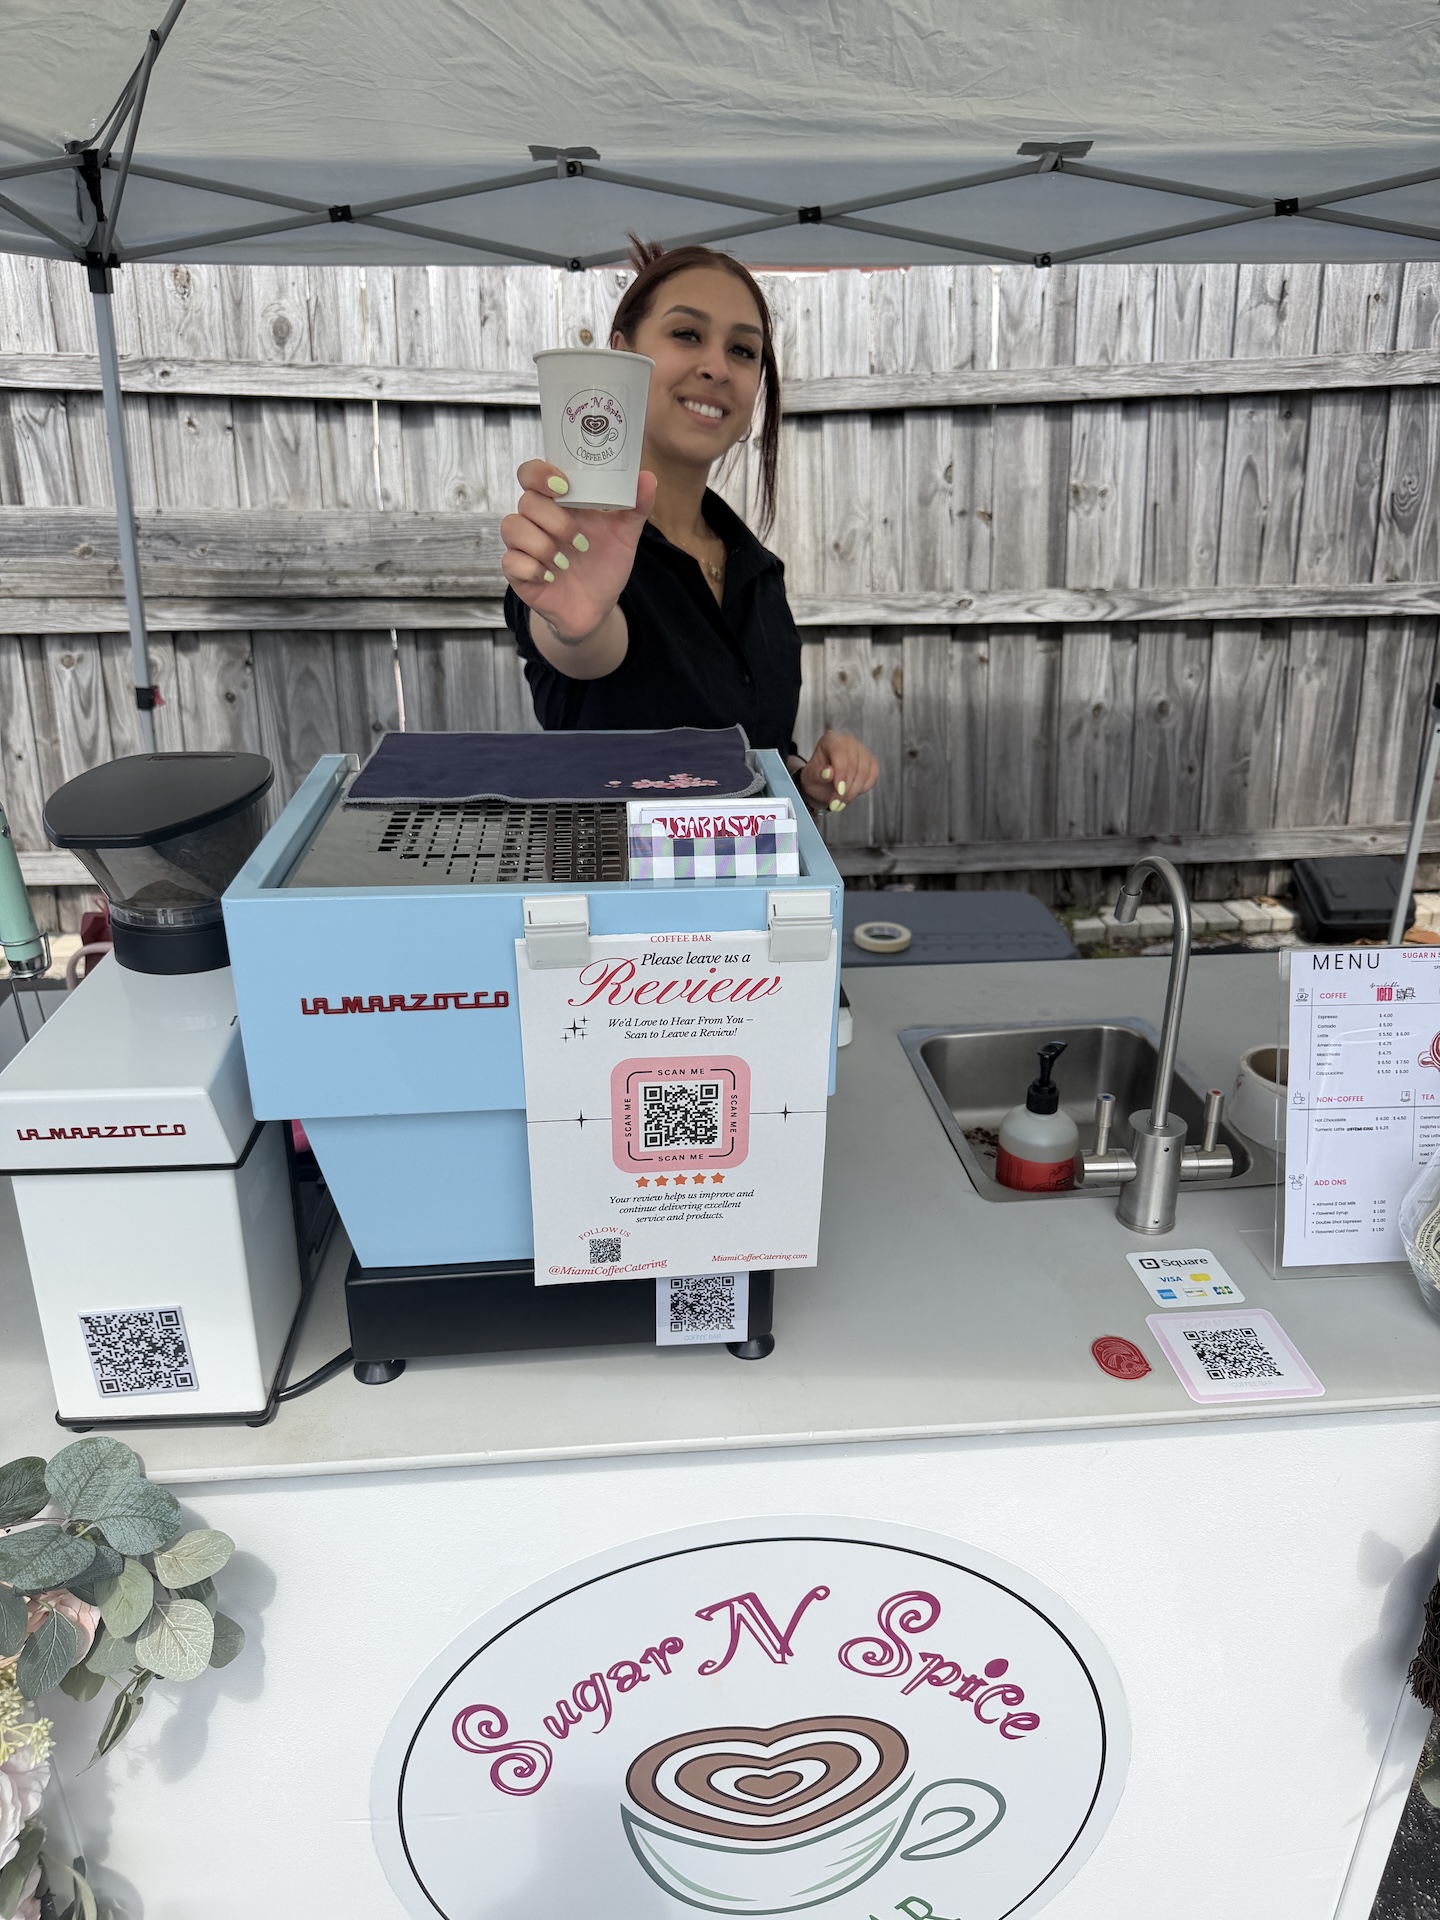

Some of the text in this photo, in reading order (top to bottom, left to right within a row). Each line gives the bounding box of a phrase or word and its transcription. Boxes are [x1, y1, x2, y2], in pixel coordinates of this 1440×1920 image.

[566, 397, 623, 424] Sugar N Spice
[576, 446, 615, 461] COFFEE BAR
[650, 934, 712, 943] COFFEE BAR
[641, 951, 751, 966] Please leave us a
[1313, 953, 1380, 970] MENU
[567, 957, 783, 1007] Review
[1376, 987, 1393, 1002] ICED
[301, 998, 329, 1015] LA
[608, 1018, 632, 1028] We'd
[634, 1017, 657, 1027] Love
[659, 1018, 669, 1027] to
[671, 1017, 695, 1026] Hear
[697, 1016, 724, 1025] From
[726, 1015, 744, 1025] You
[625, 1031, 648, 1040] Scan
[650, 1031, 659, 1039] to
[661, 1030, 688, 1039] Leave
[700, 1028, 738, 1038] Review!
[1316, 1095, 1364, 1103] NON-COFFEE
[624, 1098, 632, 1137] SCAN ME
[730, 1094, 738, 1133] SCAN ME
[17, 1129, 39, 1141] LA
[658, 1154, 685, 1162] SCAN
[609, 1196, 631, 1204] Your
[632, 1194, 662, 1203] review
[664, 1191, 686, 1202] helps
[699, 1190, 735, 1200] improve
[736, 1189, 755, 1198] and
[619, 1201, 741, 1214] continue delivering excellent
[636, 1212, 724, 1223] service and products.
[578, 1226, 631, 1241] FOLLOW US
[711, 1253, 808, 1263] MiamiCoffeeCatering.com
[1160, 1258, 1209, 1268] Square
[548, 1259, 668, 1277] @MiamiCoffeeCatering
[452, 1585, 1041, 1796] Sugar N Spice
